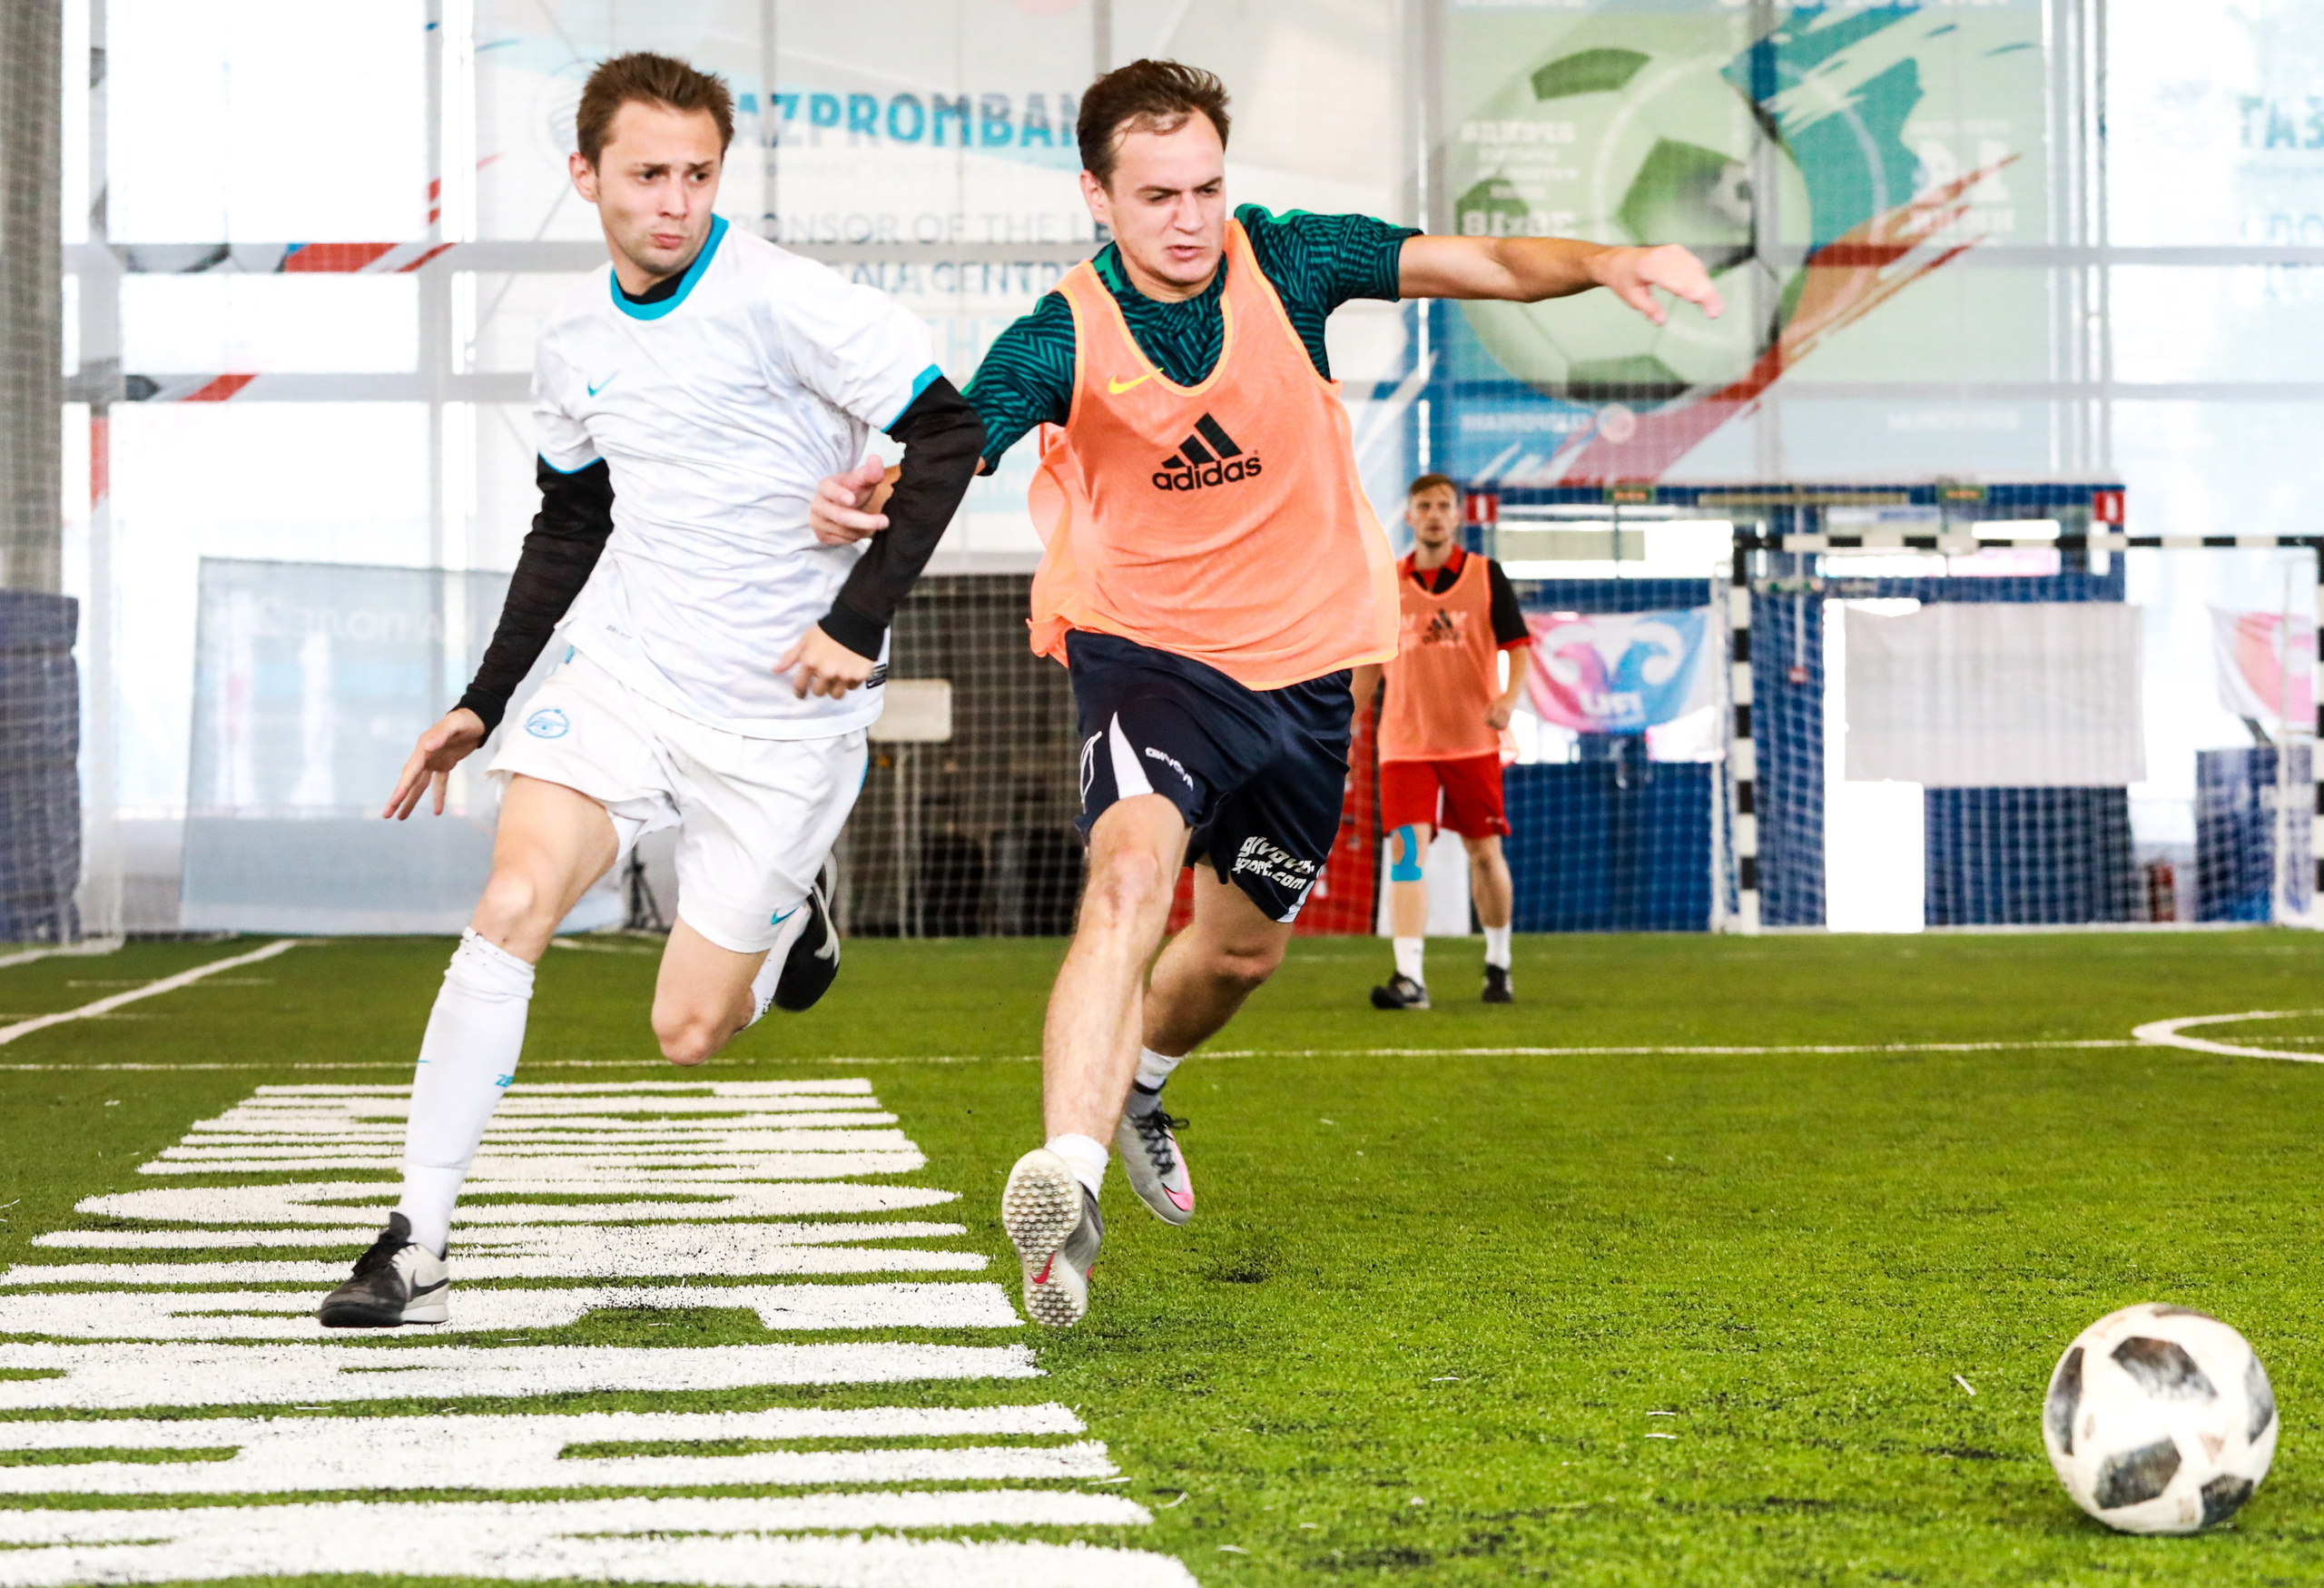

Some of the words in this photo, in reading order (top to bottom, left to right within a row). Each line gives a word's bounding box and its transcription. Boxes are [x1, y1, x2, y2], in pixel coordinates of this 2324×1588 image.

[734, 93, 1079, 147] AZPROMBAN
[730, 212, 896, 245] PONSOR
[983, 212, 1055, 244] THE
[1072, 212, 1112, 244] LE
[931, 260, 1080, 296] CENTR
[1152, 457, 1263, 491] adidas
